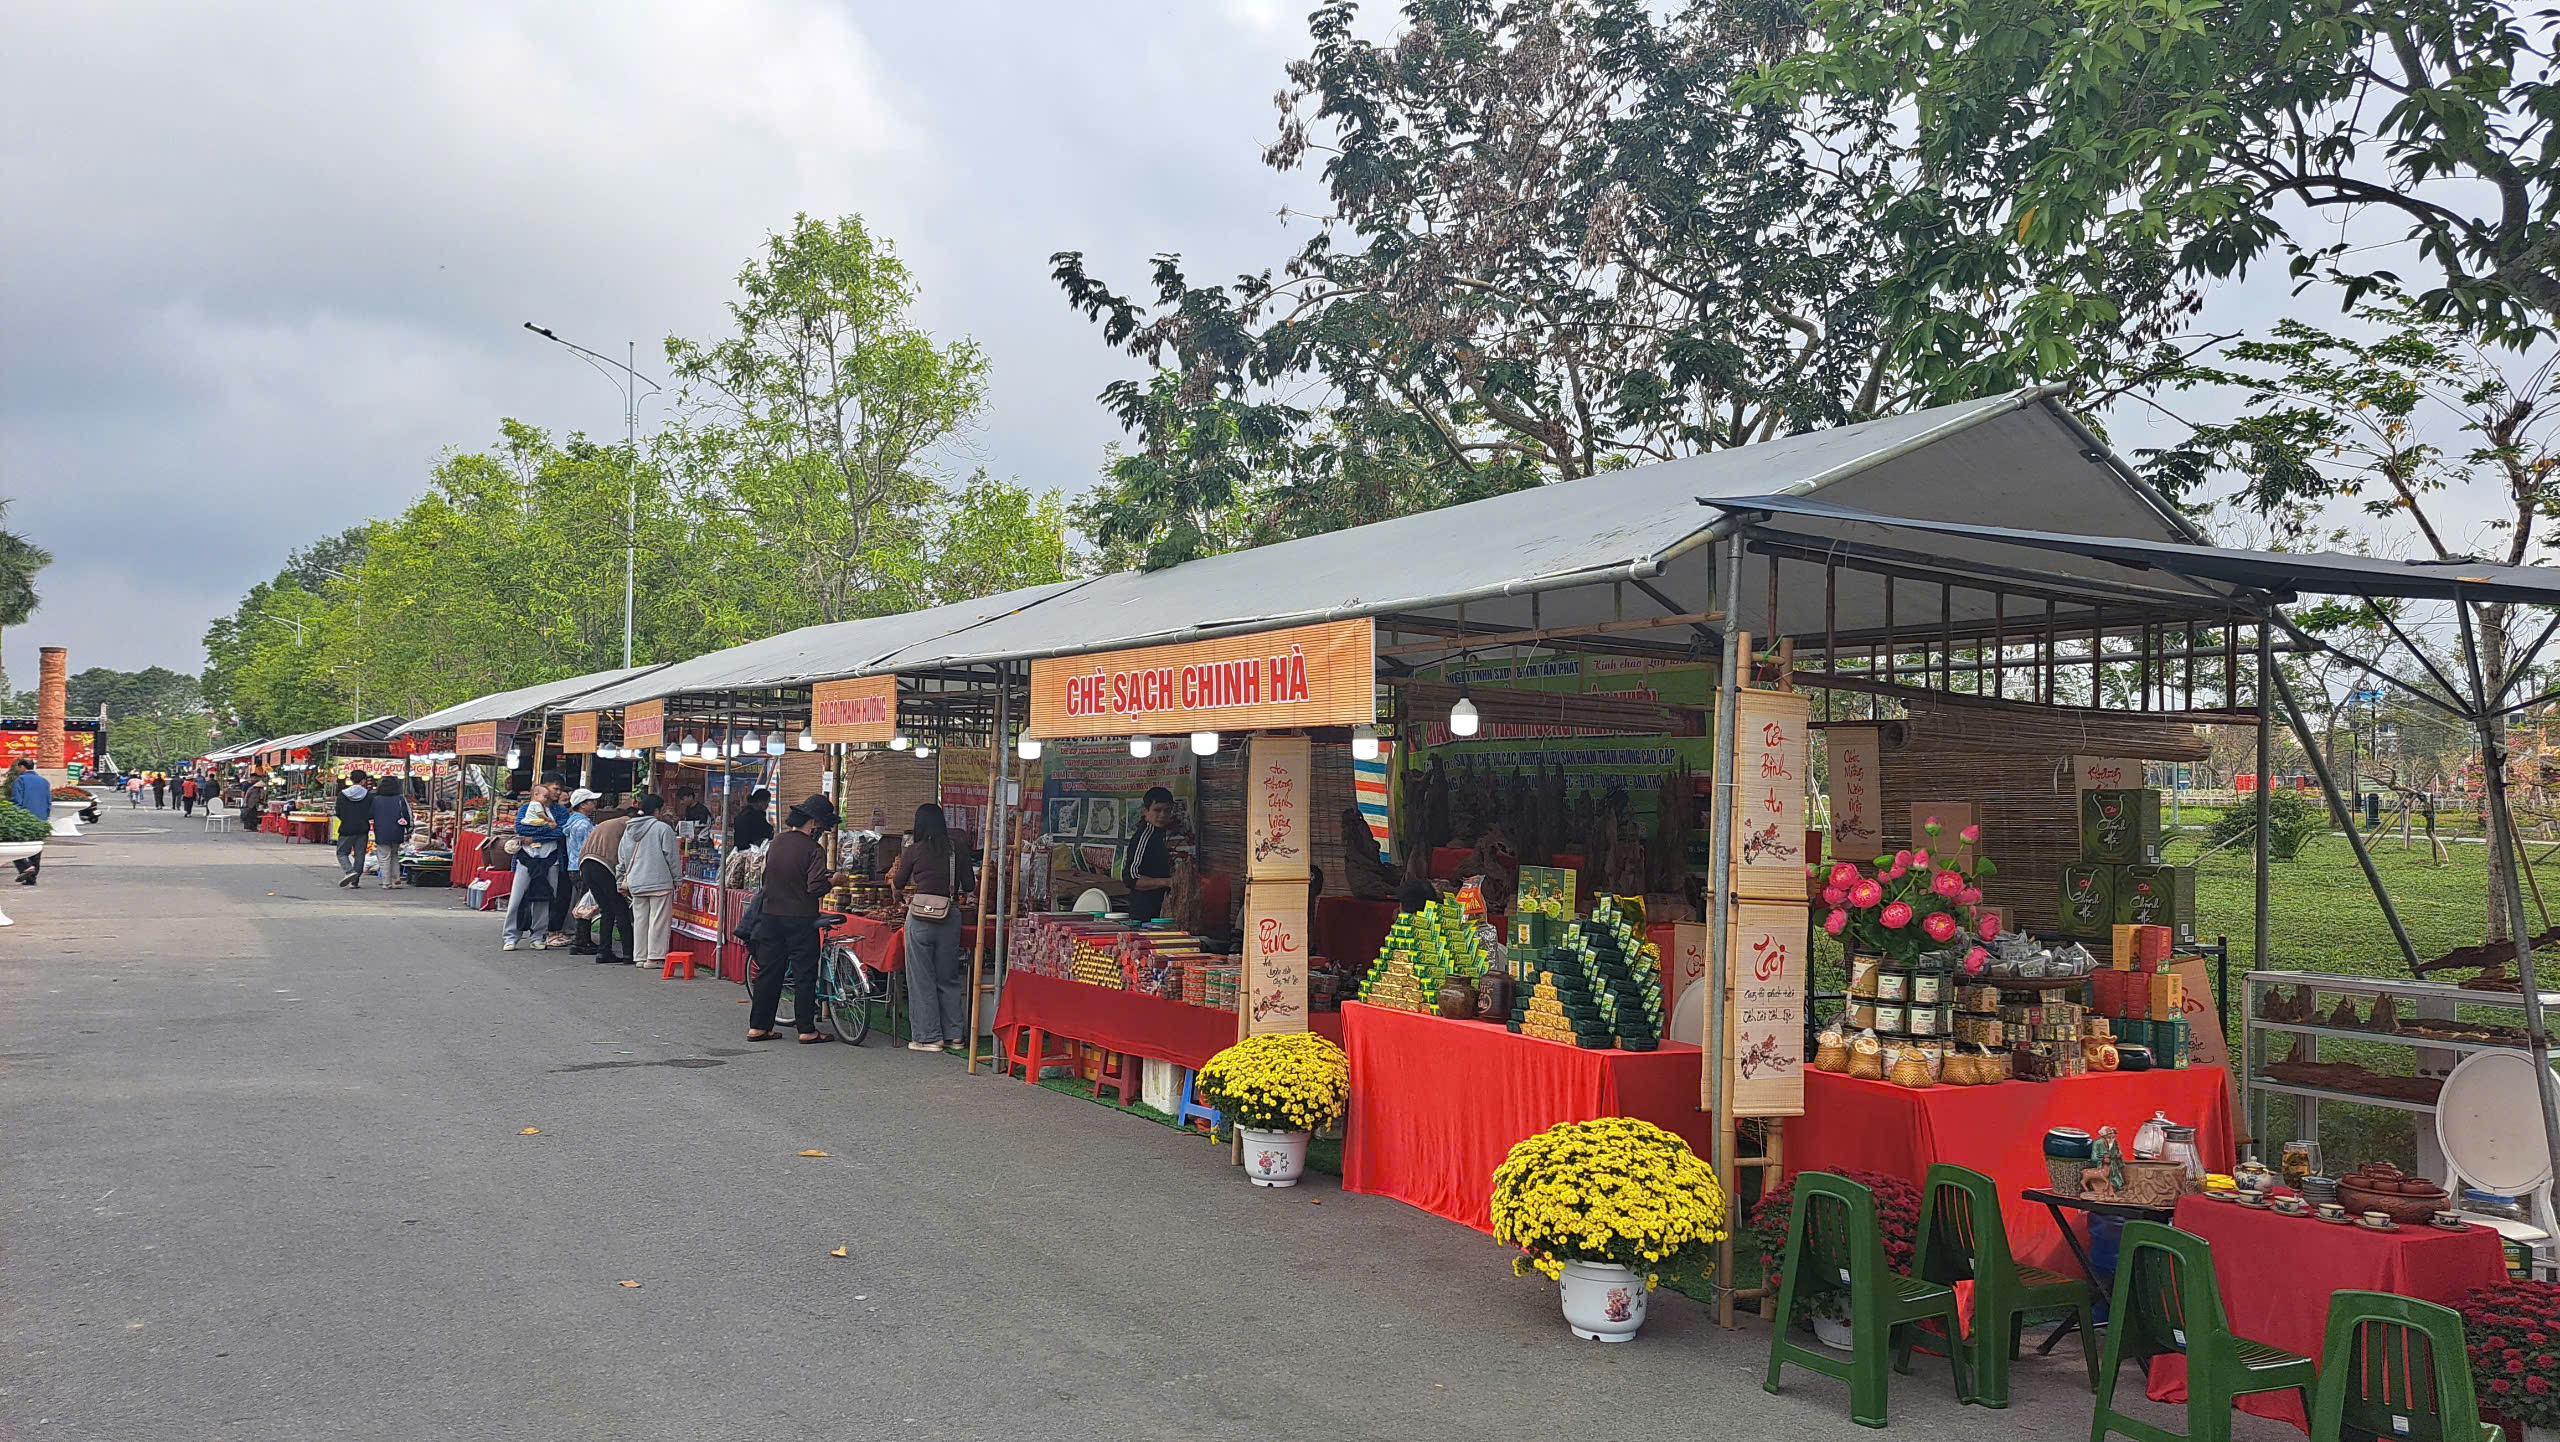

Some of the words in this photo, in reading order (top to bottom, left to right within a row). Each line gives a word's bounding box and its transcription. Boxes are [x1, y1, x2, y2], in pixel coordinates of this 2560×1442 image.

[1066, 666, 1106, 717] CHÈ
[1112, 667, 1174, 722] SẠCH
[1181, 657, 1261, 711] CHINH
[1268, 643, 1309, 704] HÀ
[1472, 669, 1493, 683] TNHH
[1559, 659, 1580, 676] PHÁT
[839, 699, 861, 726] THANH
[1763, 720, 1793, 752] Tết
[1641, 748, 1657, 764] CAO
[1760, 754, 1793, 781] Bình
[1764, 787, 1784, 814] An
[1753, 933, 1792, 982] Tài
